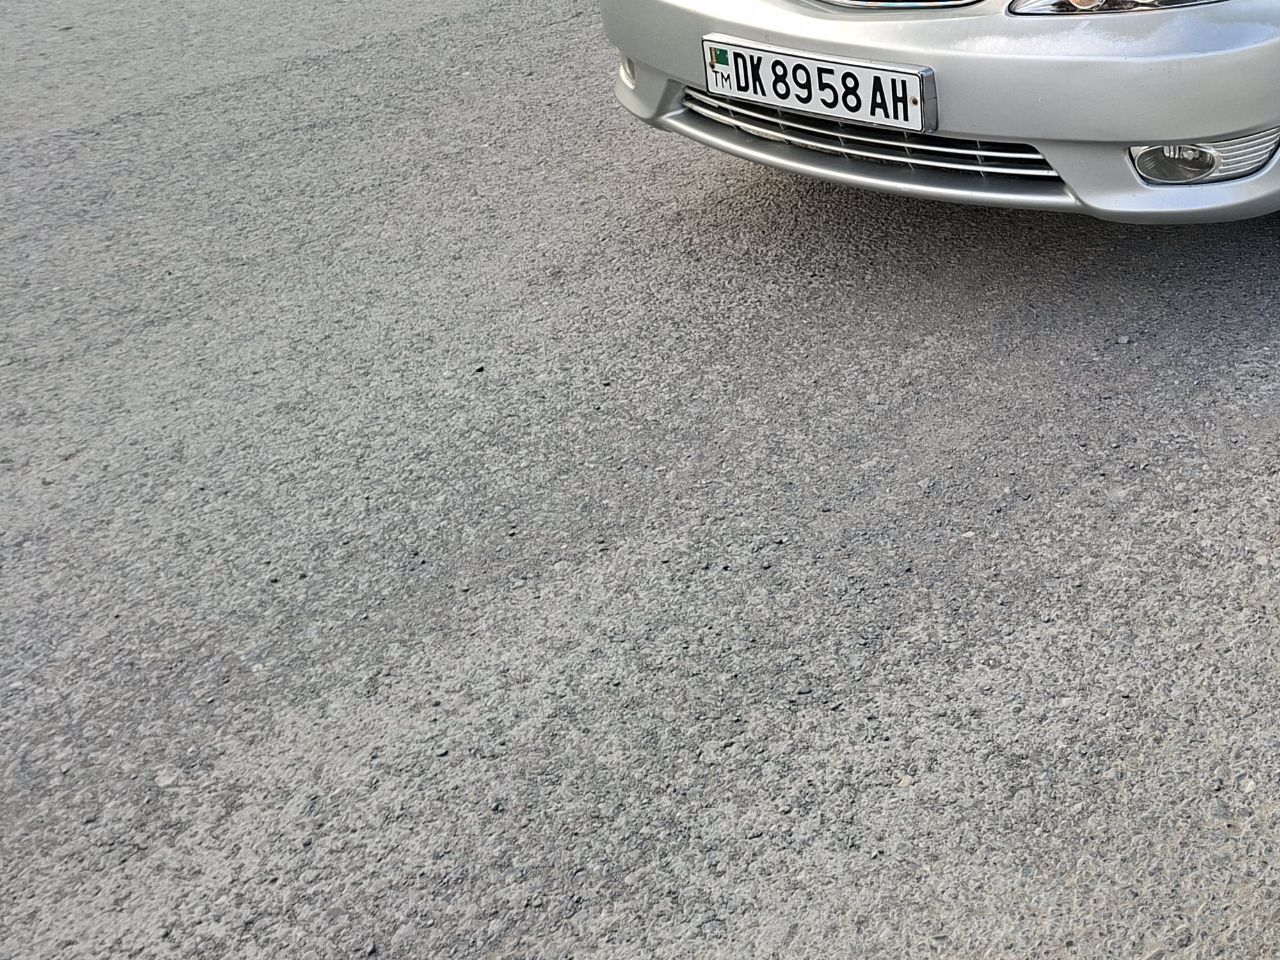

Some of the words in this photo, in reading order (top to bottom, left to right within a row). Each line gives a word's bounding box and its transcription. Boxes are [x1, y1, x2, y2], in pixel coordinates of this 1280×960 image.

[712, 70, 732, 90] TM
[733, 51, 767, 97] DK
[771, 59, 862, 113] 8958
[869, 75, 909, 122] AH
